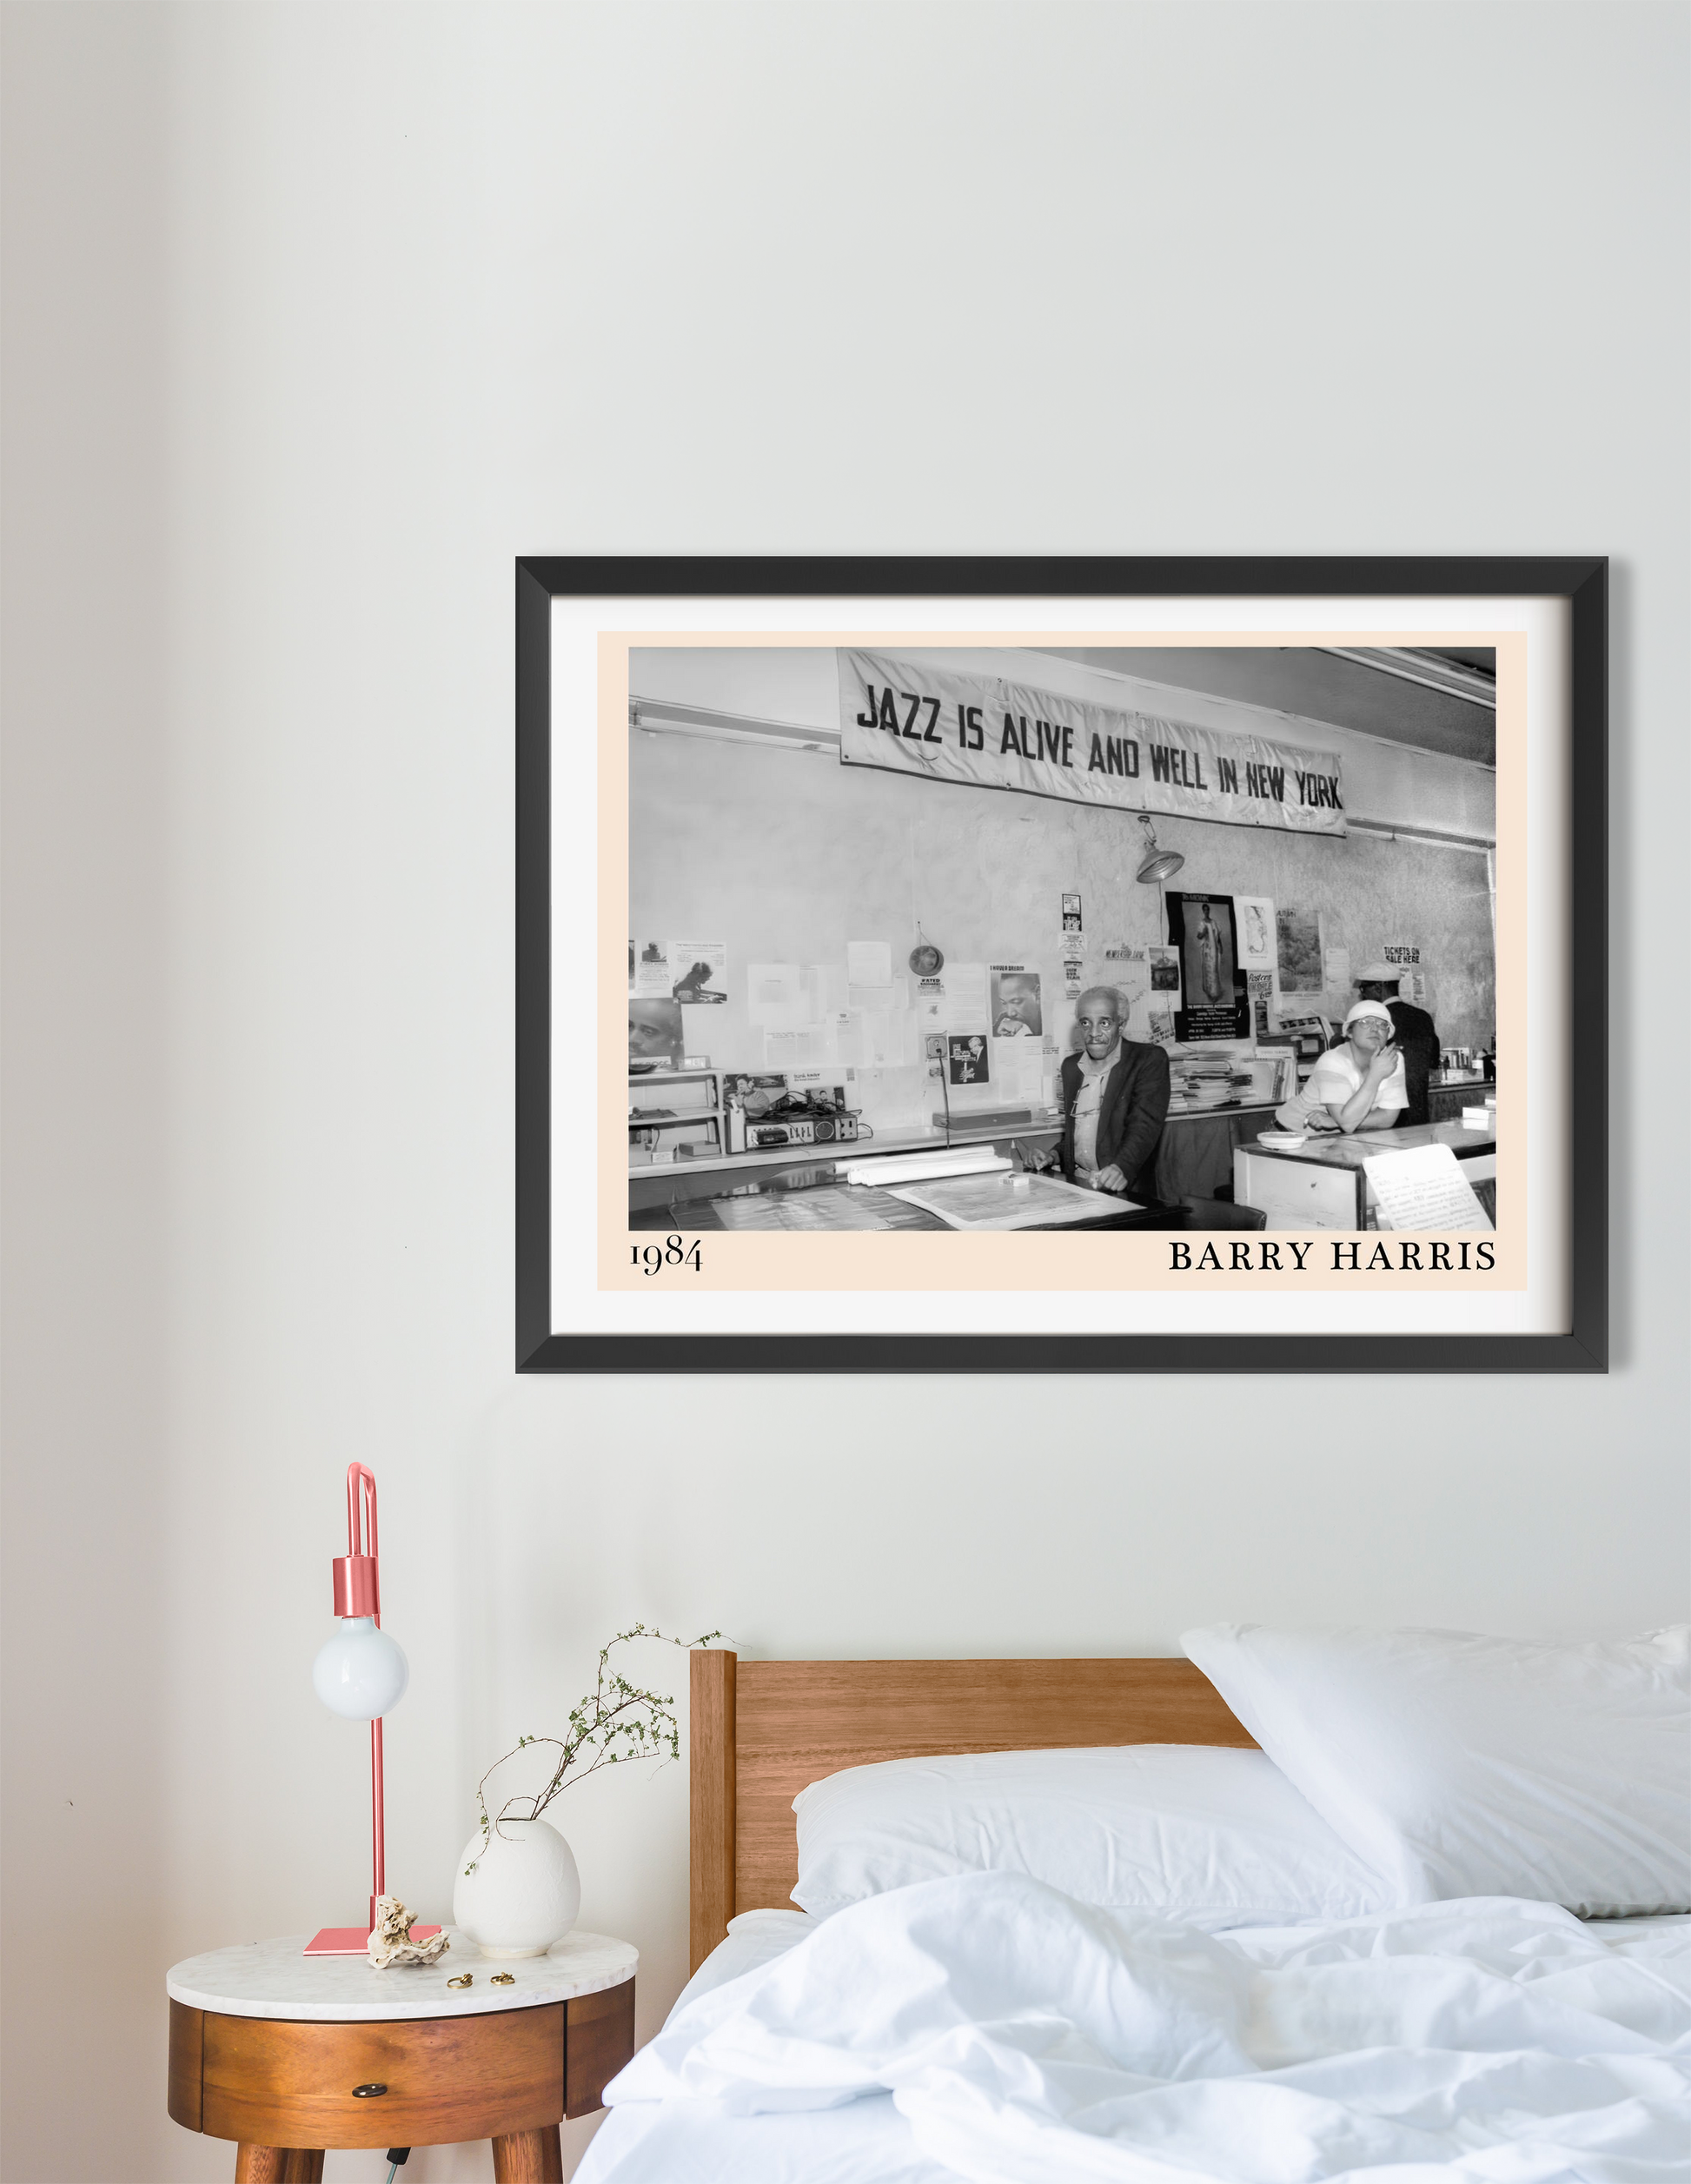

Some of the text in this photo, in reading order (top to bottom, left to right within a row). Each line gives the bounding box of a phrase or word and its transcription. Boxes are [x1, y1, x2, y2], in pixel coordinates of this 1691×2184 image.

[857, 684, 1343, 810] JAZZ IS ALIVE AND WELL IN NEW YORK
[1384, 946, 1410, 955] TICKETS
[1385, 955, 1420, 964] SALE HERE
[630, 1234, 703, 1276] 1984
[1168, 1242, 1495, 1271] BARRY HARRIS
